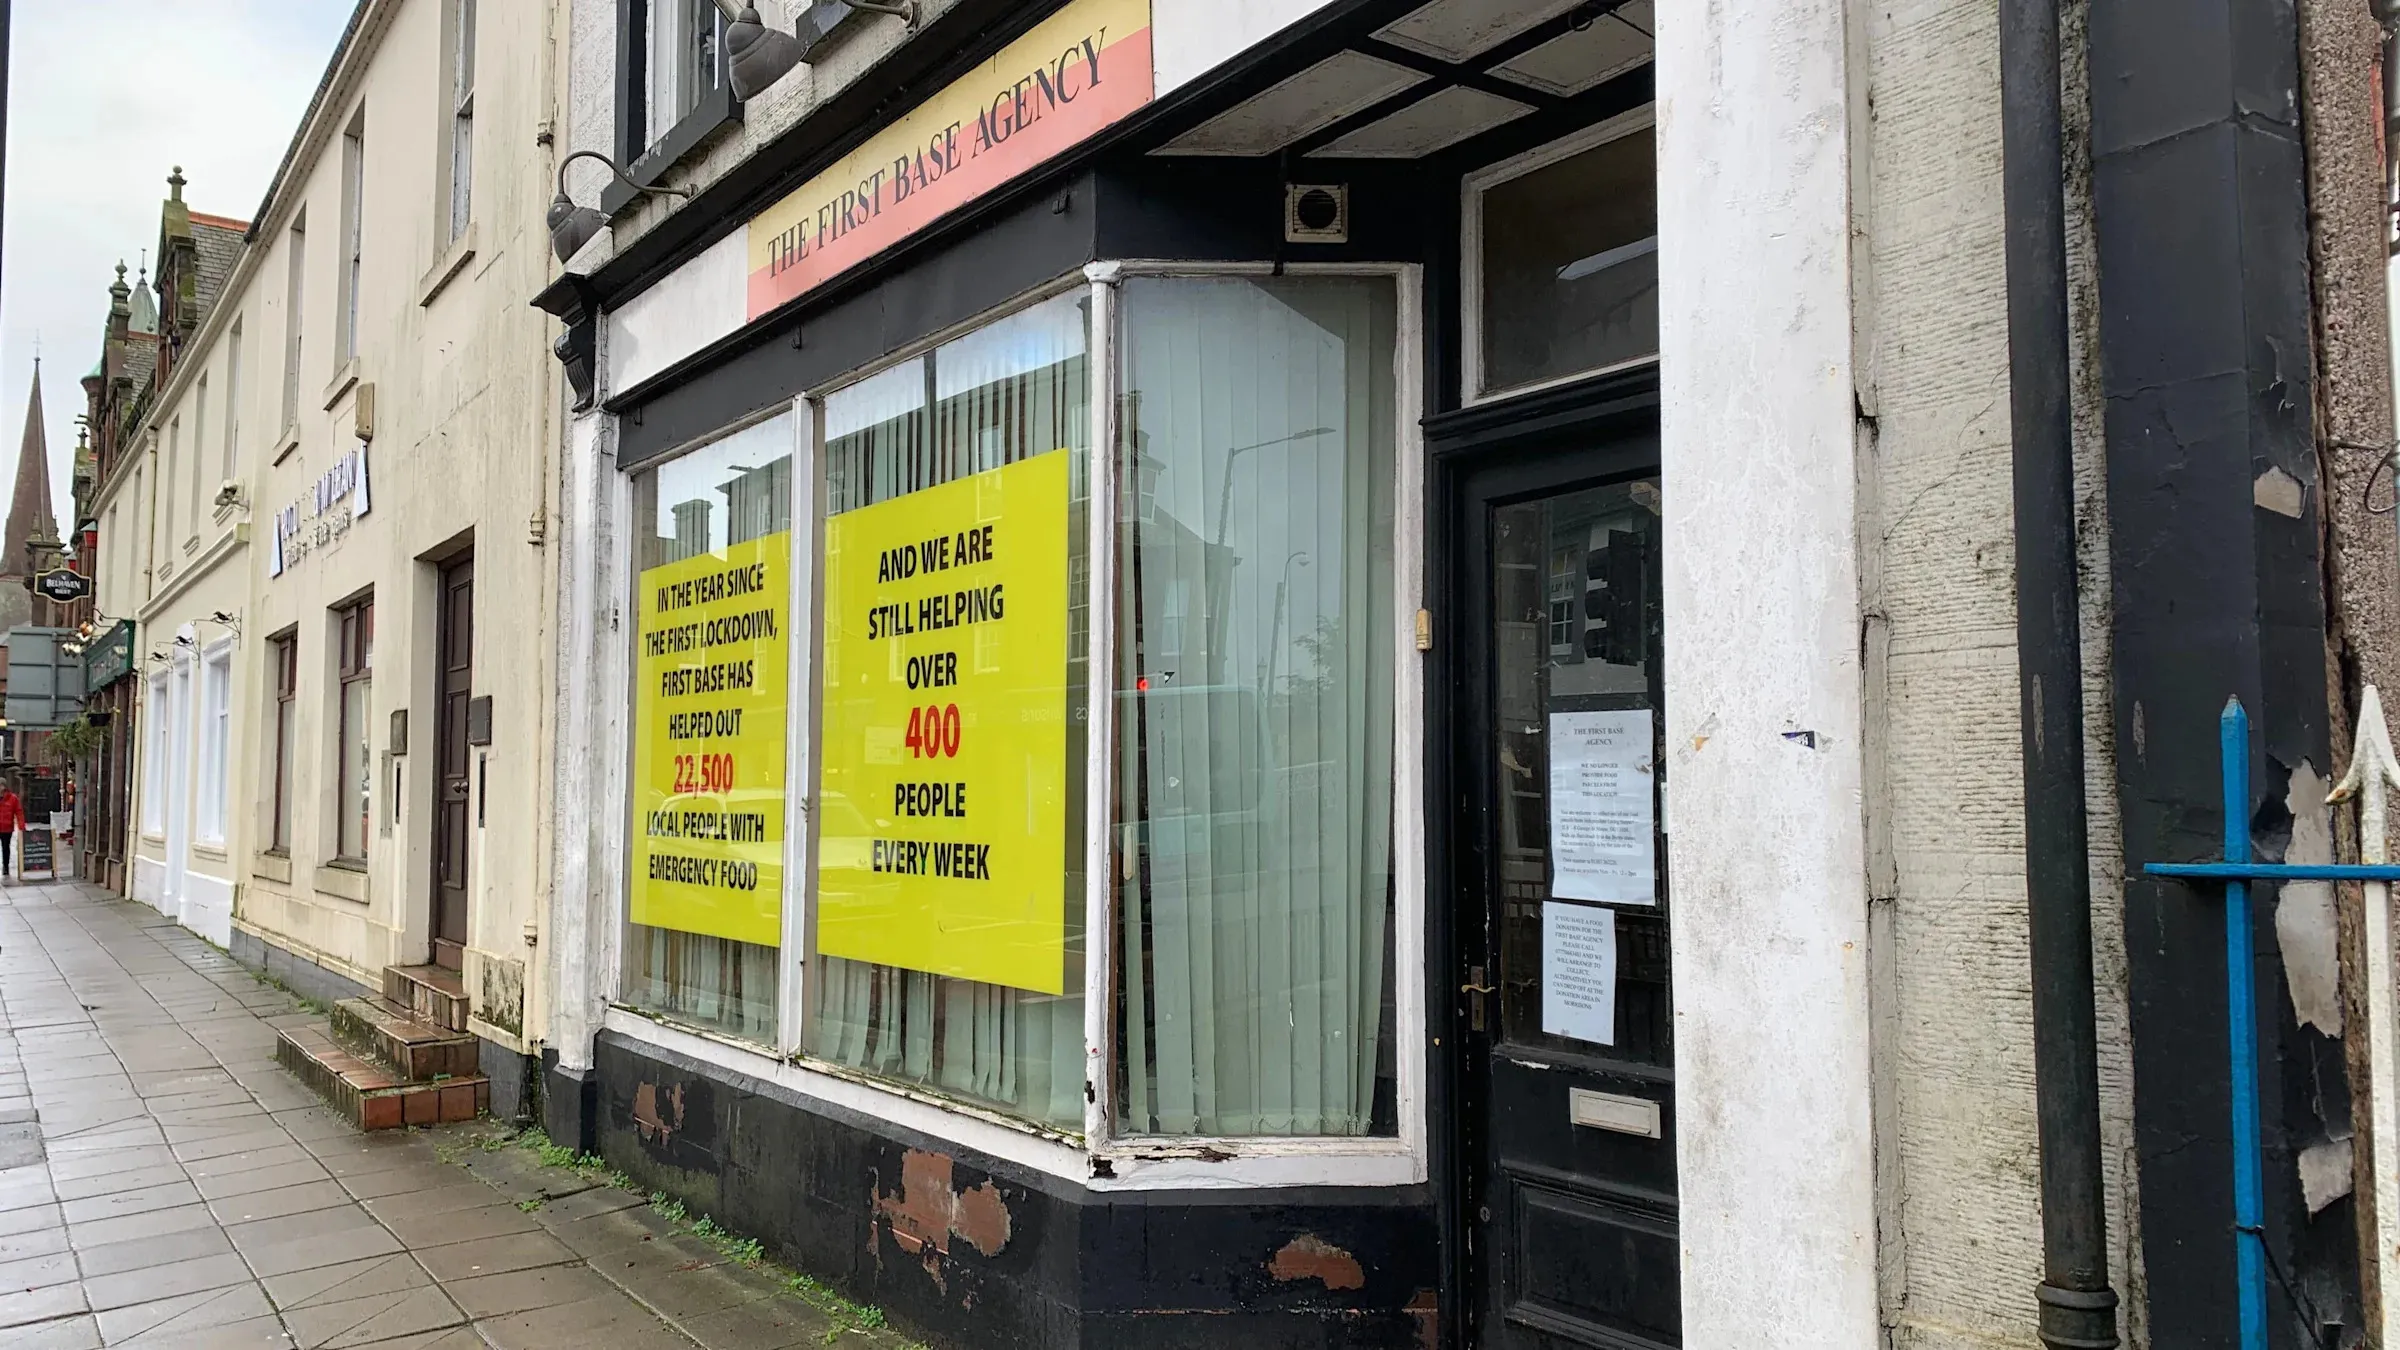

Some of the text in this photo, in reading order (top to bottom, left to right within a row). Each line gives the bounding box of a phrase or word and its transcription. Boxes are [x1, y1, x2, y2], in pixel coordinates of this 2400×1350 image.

[767, 26, 1107, 279] THE FIRST BASE AGENCY
[878, 525, 993, 584] AND WE ARE
[46, 579, 80, 589] BELHAVEN
[657, 563, 765, 613] IN THE YEAR SINCE
[868, 583, 1004, 640] STILL HELPING
[646, 608, 778, 658] THE FIRST LOCKDOWN,
[662, 659, 753, 698] FIRST BASE HAS
[907, 652, 957, 690] OVER
[669, 708, 742, 740] HELPED OUT
[905, 703, 961, 759] 400
[1585, 738, 1612, 746] AGENCY
[1608, 727, 1624, 735] BASE
[673, 753, 734, 799] 22,500
[895, 783, 966, 818] PEOPLE
[646, 810, 765, 843] LOCAL PEOPLE WITH
[649, 854, 758, 891] EMERGENCY FOOD
[873, 840, 991, 881] EVERY WEEK
